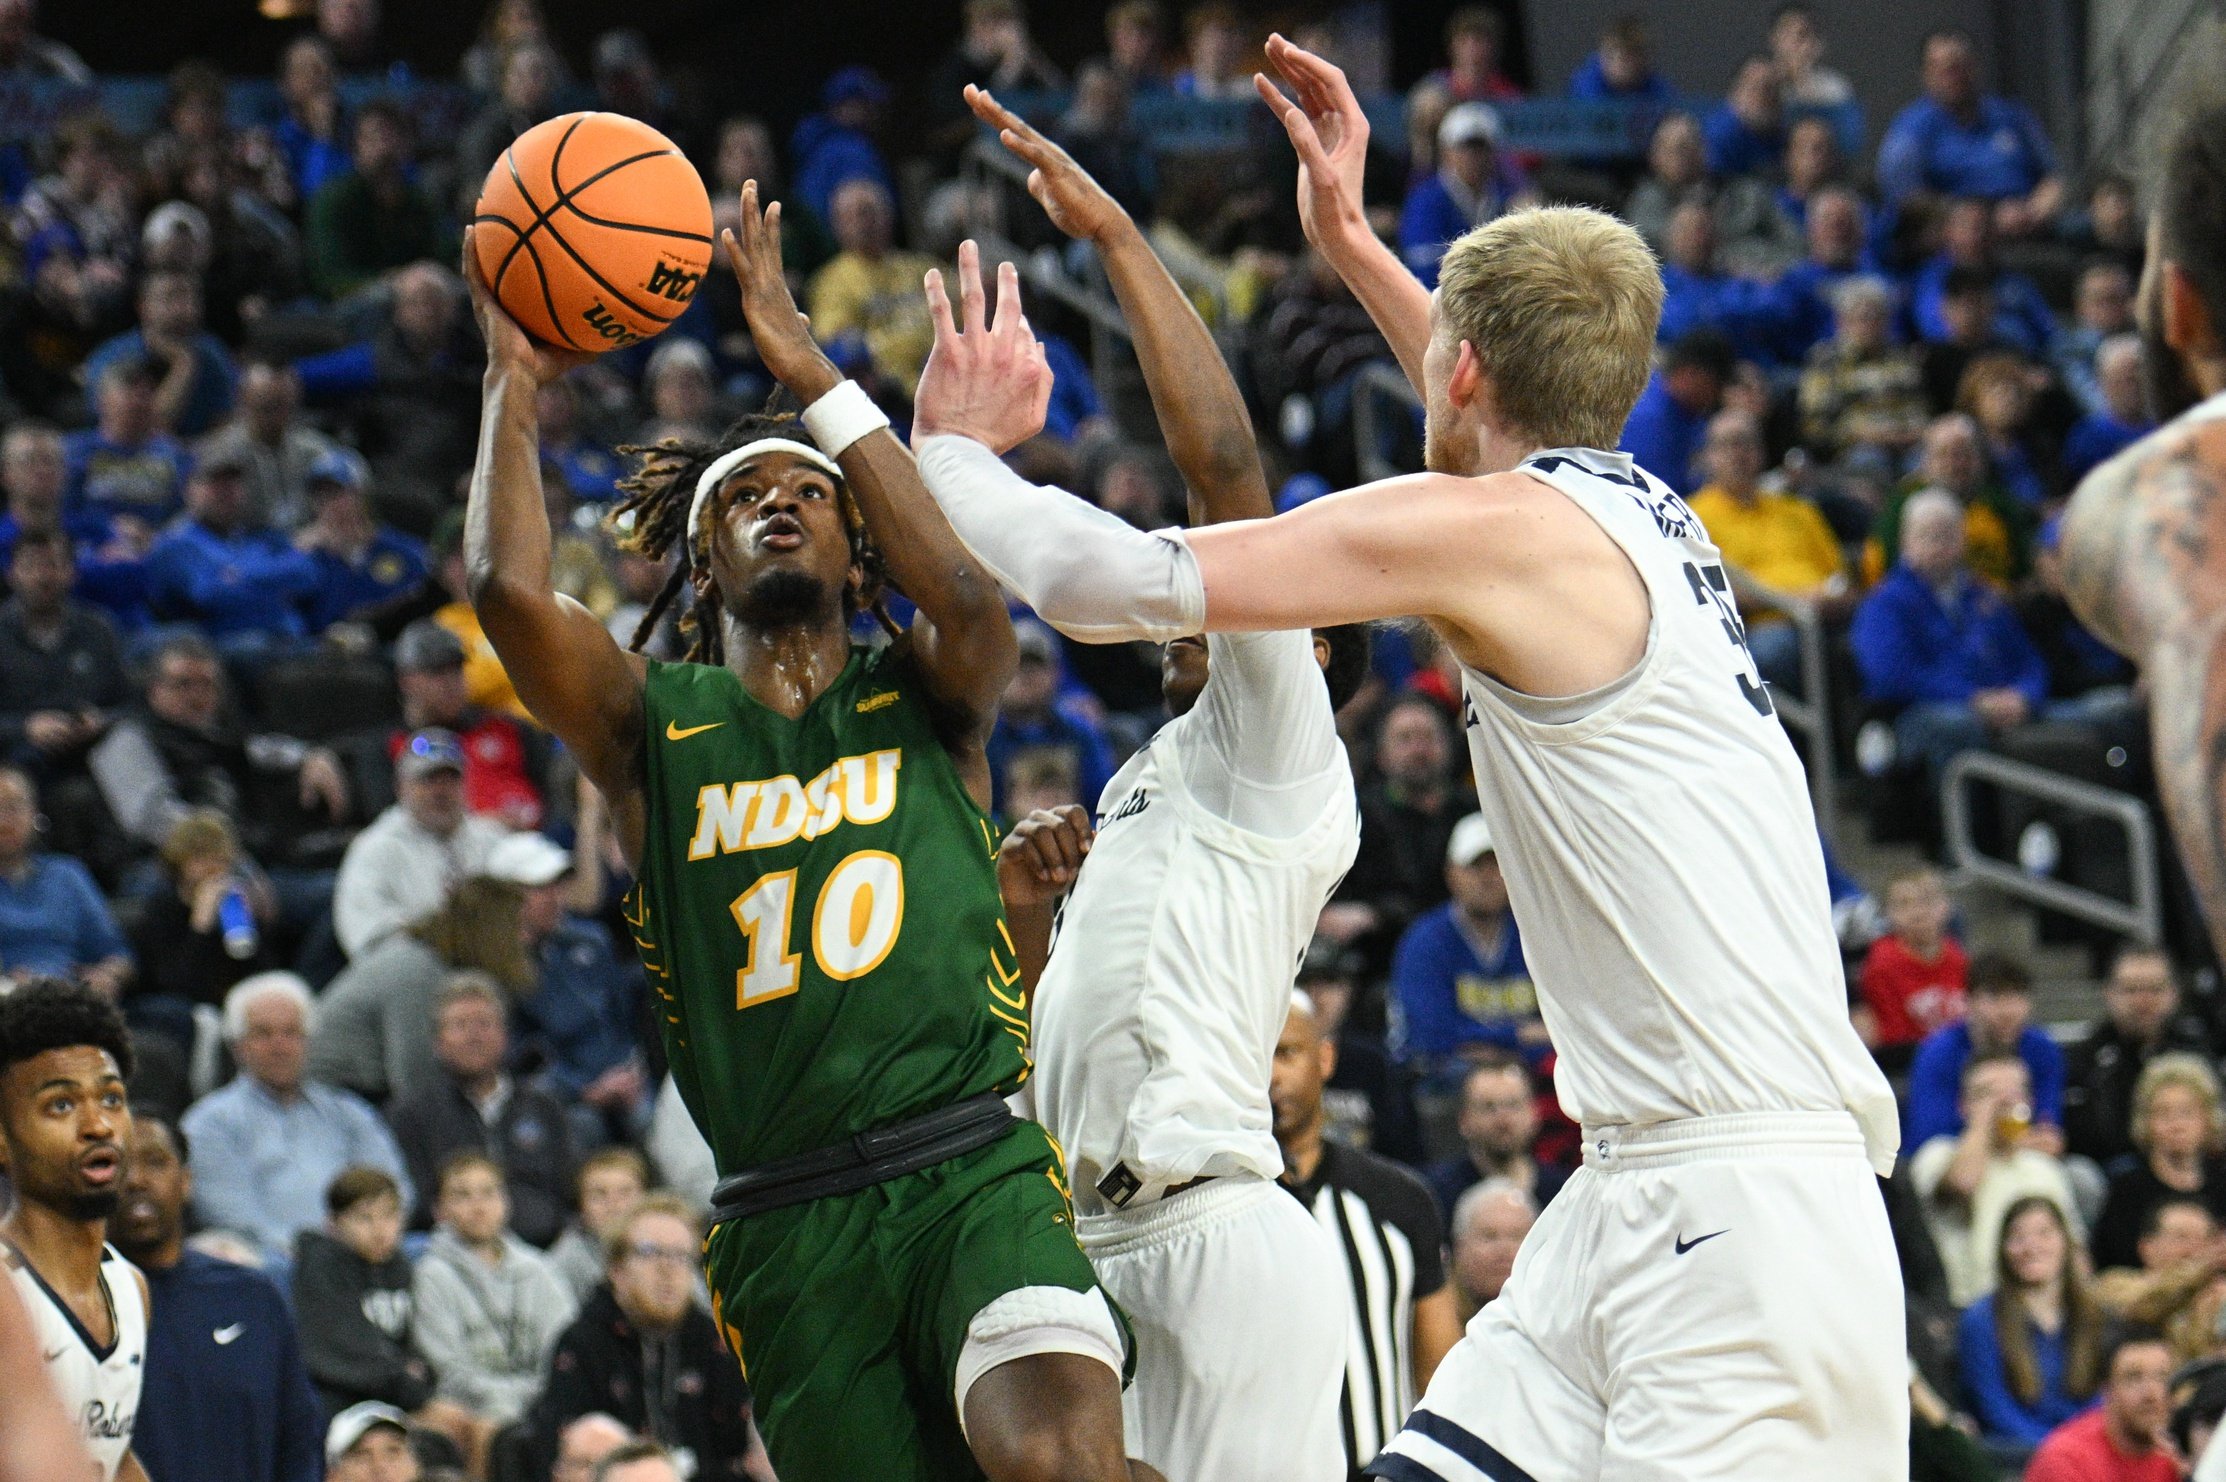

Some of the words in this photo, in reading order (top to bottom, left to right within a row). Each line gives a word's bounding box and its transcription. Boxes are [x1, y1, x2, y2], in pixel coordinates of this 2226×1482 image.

[646, 260, 701, 302] CAA
[688, 748, 901, 861] NDSU
[730, 849, 905, 1010] 10
